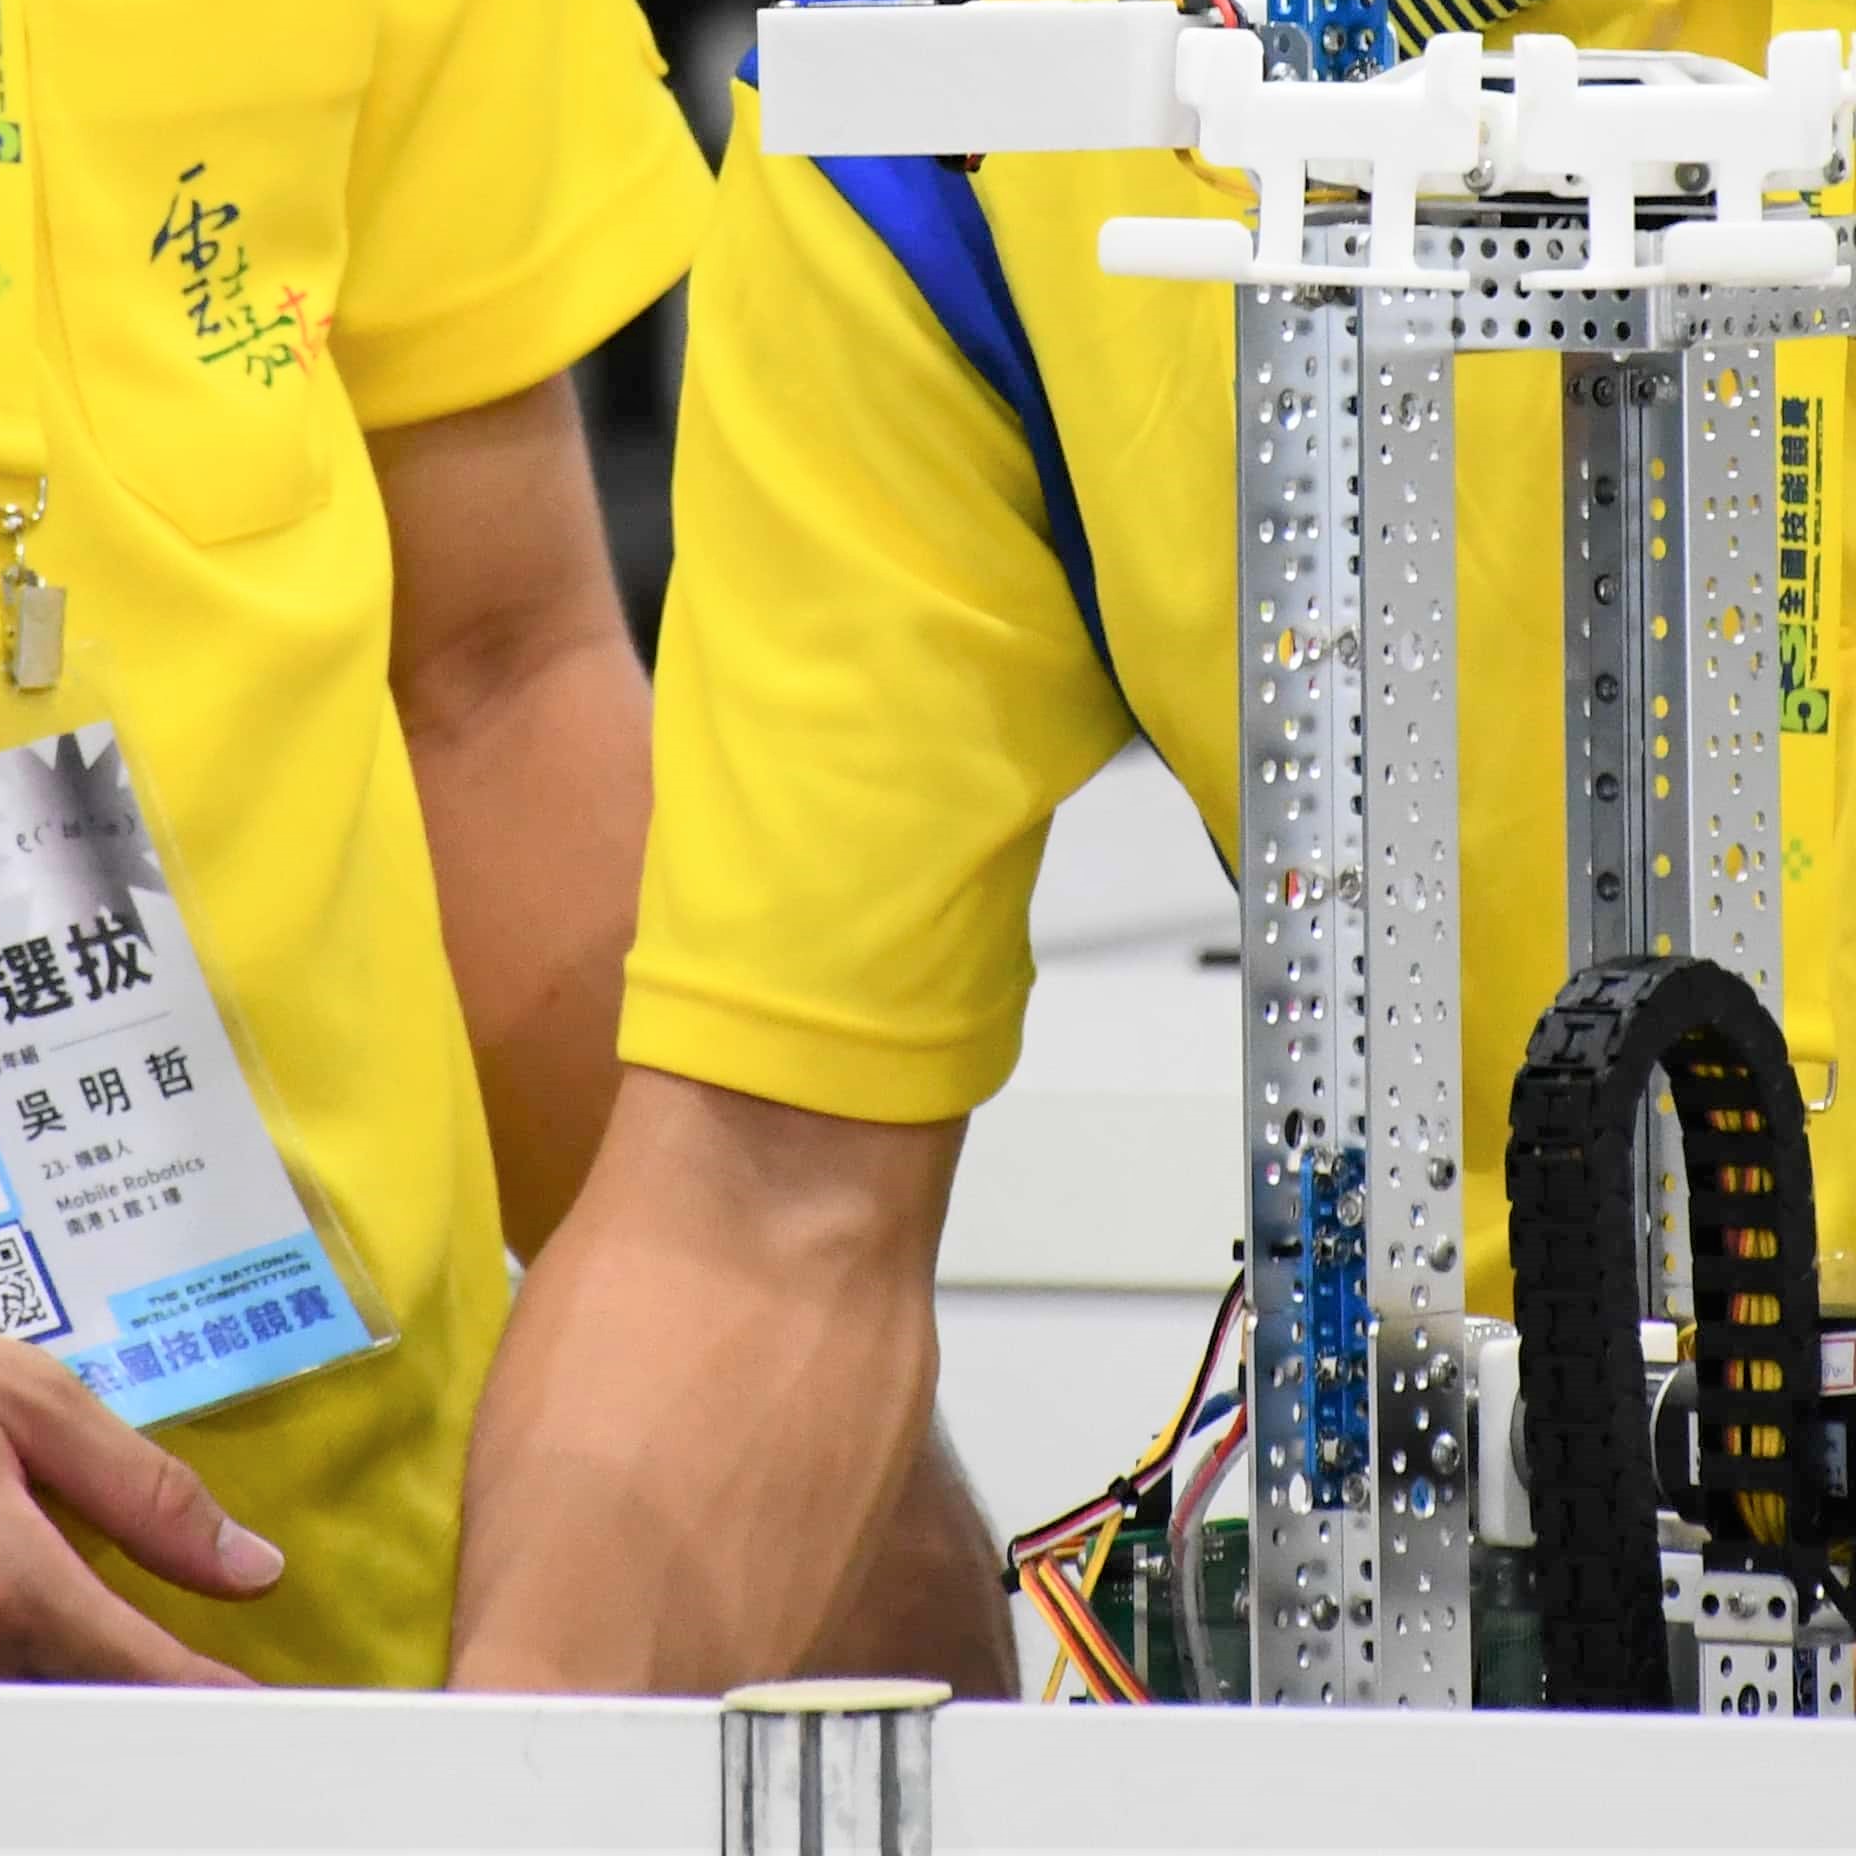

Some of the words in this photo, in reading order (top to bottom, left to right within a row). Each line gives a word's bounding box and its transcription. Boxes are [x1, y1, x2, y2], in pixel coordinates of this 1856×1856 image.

[16, 1045, 195, 1142] 吳明哲
[55, 1182, 121, 1213] Mobile
[123, 1156, 207, 1190] Robotics
[78, 1285, 336, 1397] 全國技能競賽
